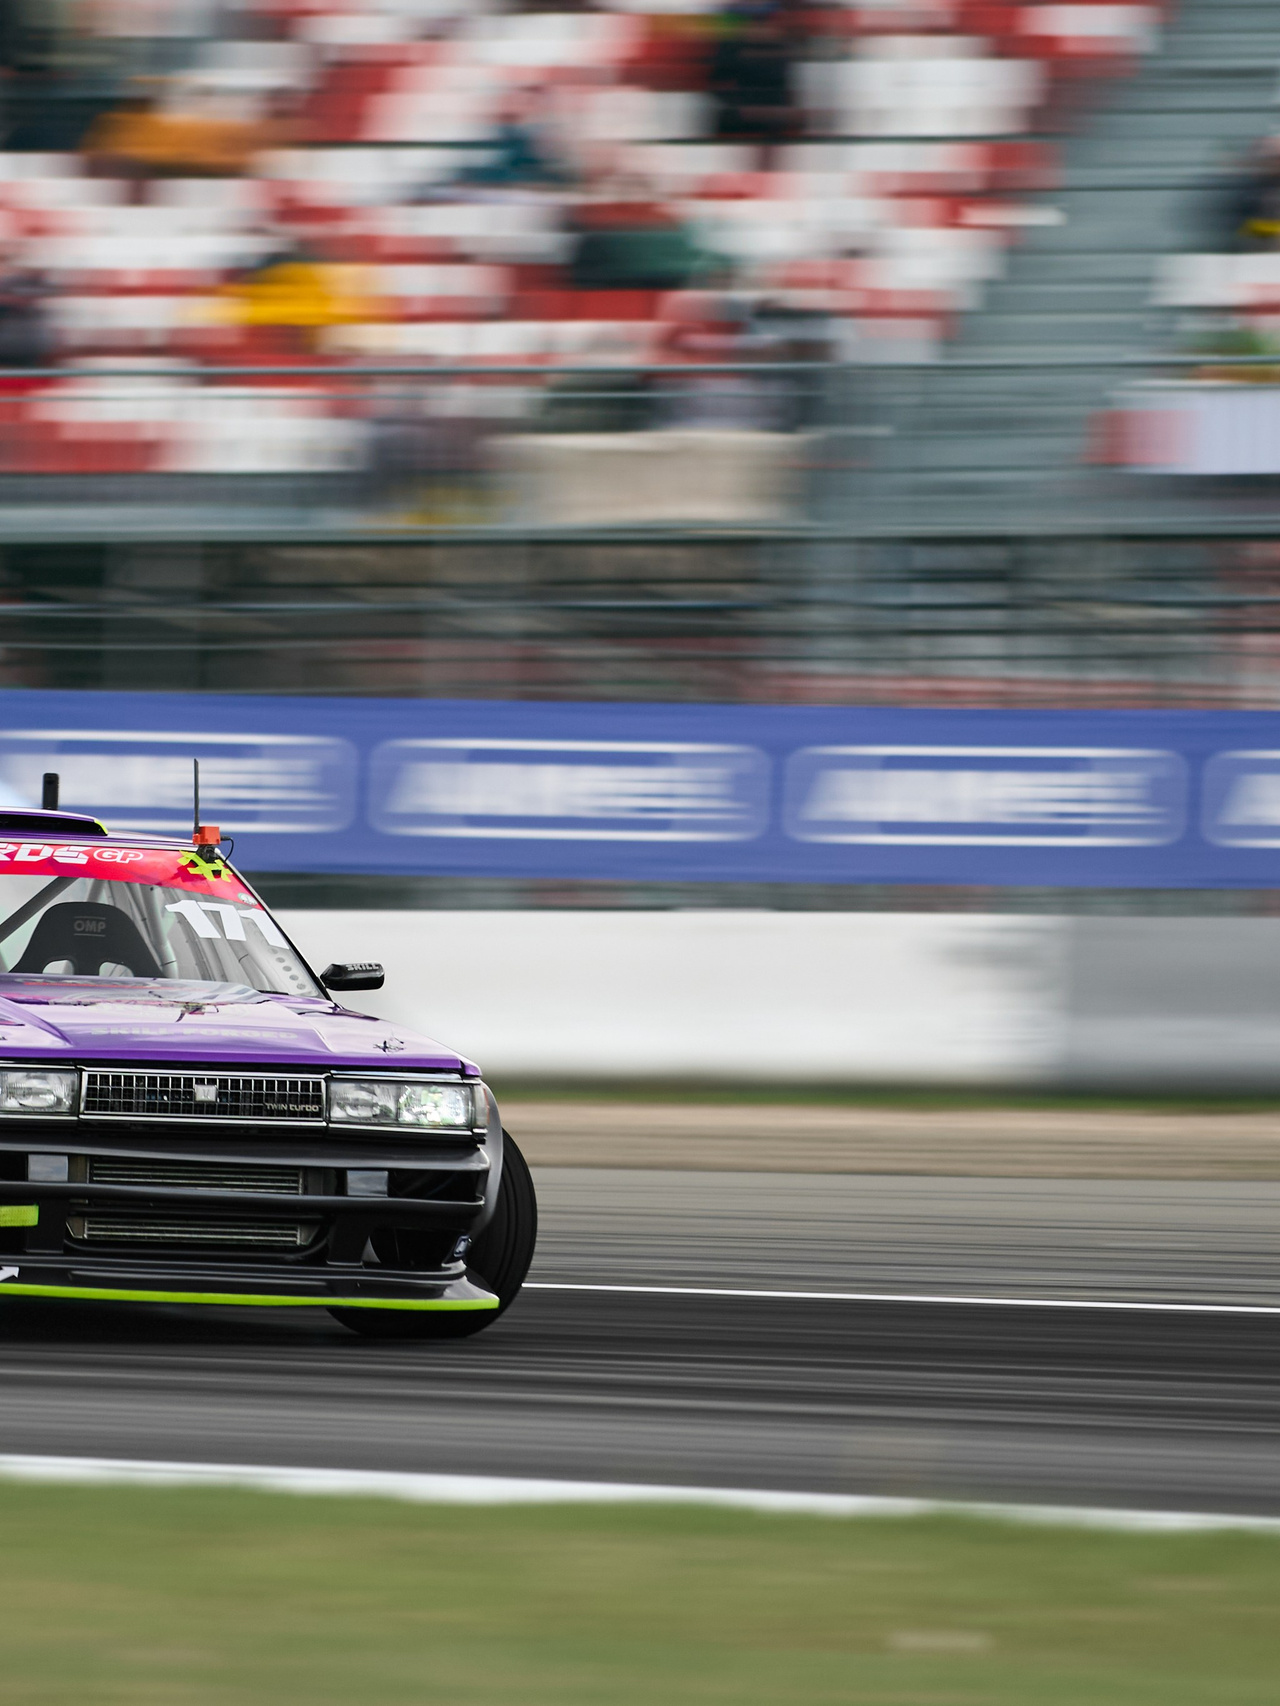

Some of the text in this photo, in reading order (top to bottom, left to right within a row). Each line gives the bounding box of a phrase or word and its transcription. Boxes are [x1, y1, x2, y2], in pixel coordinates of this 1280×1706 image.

[94, 847, 144, 864] GP
[74, 920, 106, 933] OMP
[165, 900, 290, 950] 171
[345, 963, 380, 971] SKILL
[90, 1026, 169, 1036] SKILL
[264, 1102, 287, 1111] TWIN
